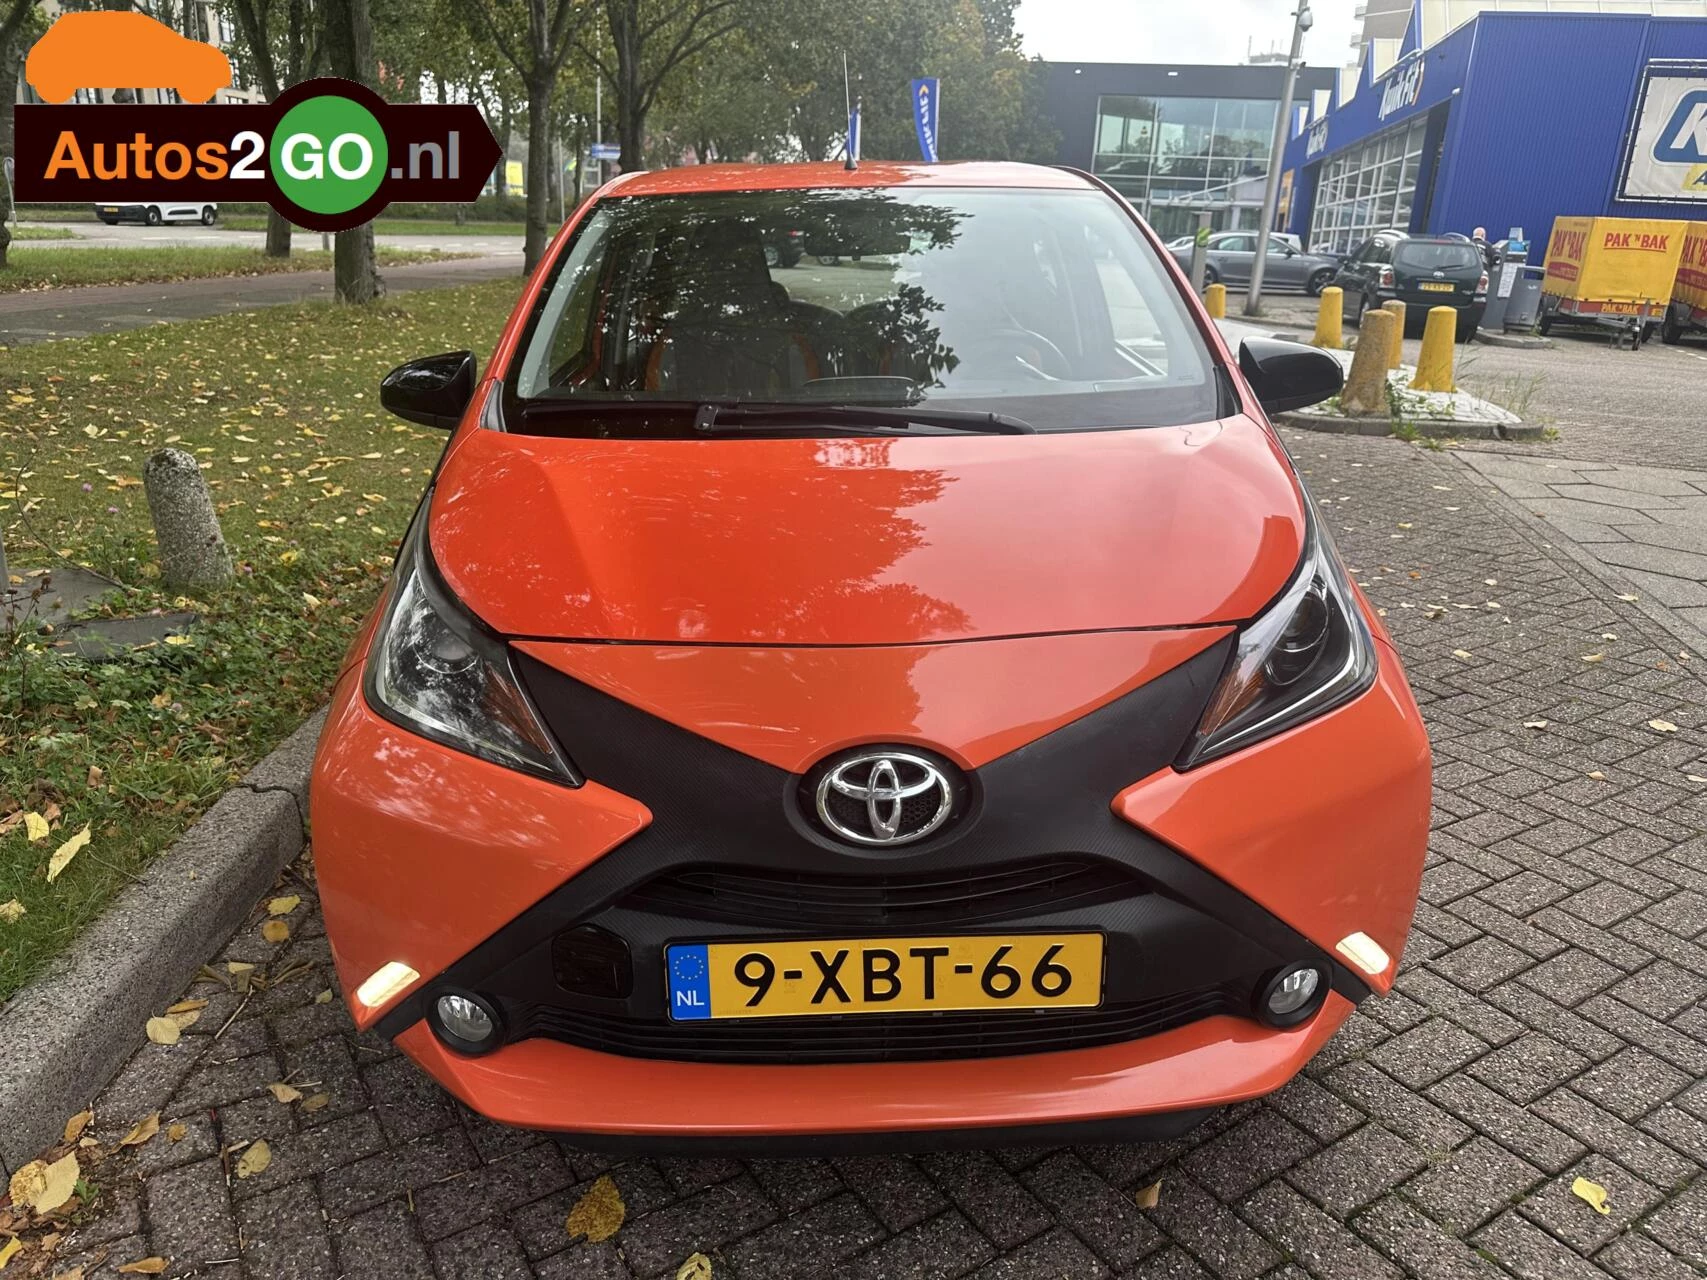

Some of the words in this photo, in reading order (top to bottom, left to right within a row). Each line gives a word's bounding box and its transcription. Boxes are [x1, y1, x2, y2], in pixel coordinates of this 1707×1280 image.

[1604, 232, 1632, 248] PAK
[1640, 233, 1670, 250] BAK
[734, 945, 1072, 1007] 9-XBT-66
[676, 990, 705, 1007] NL
